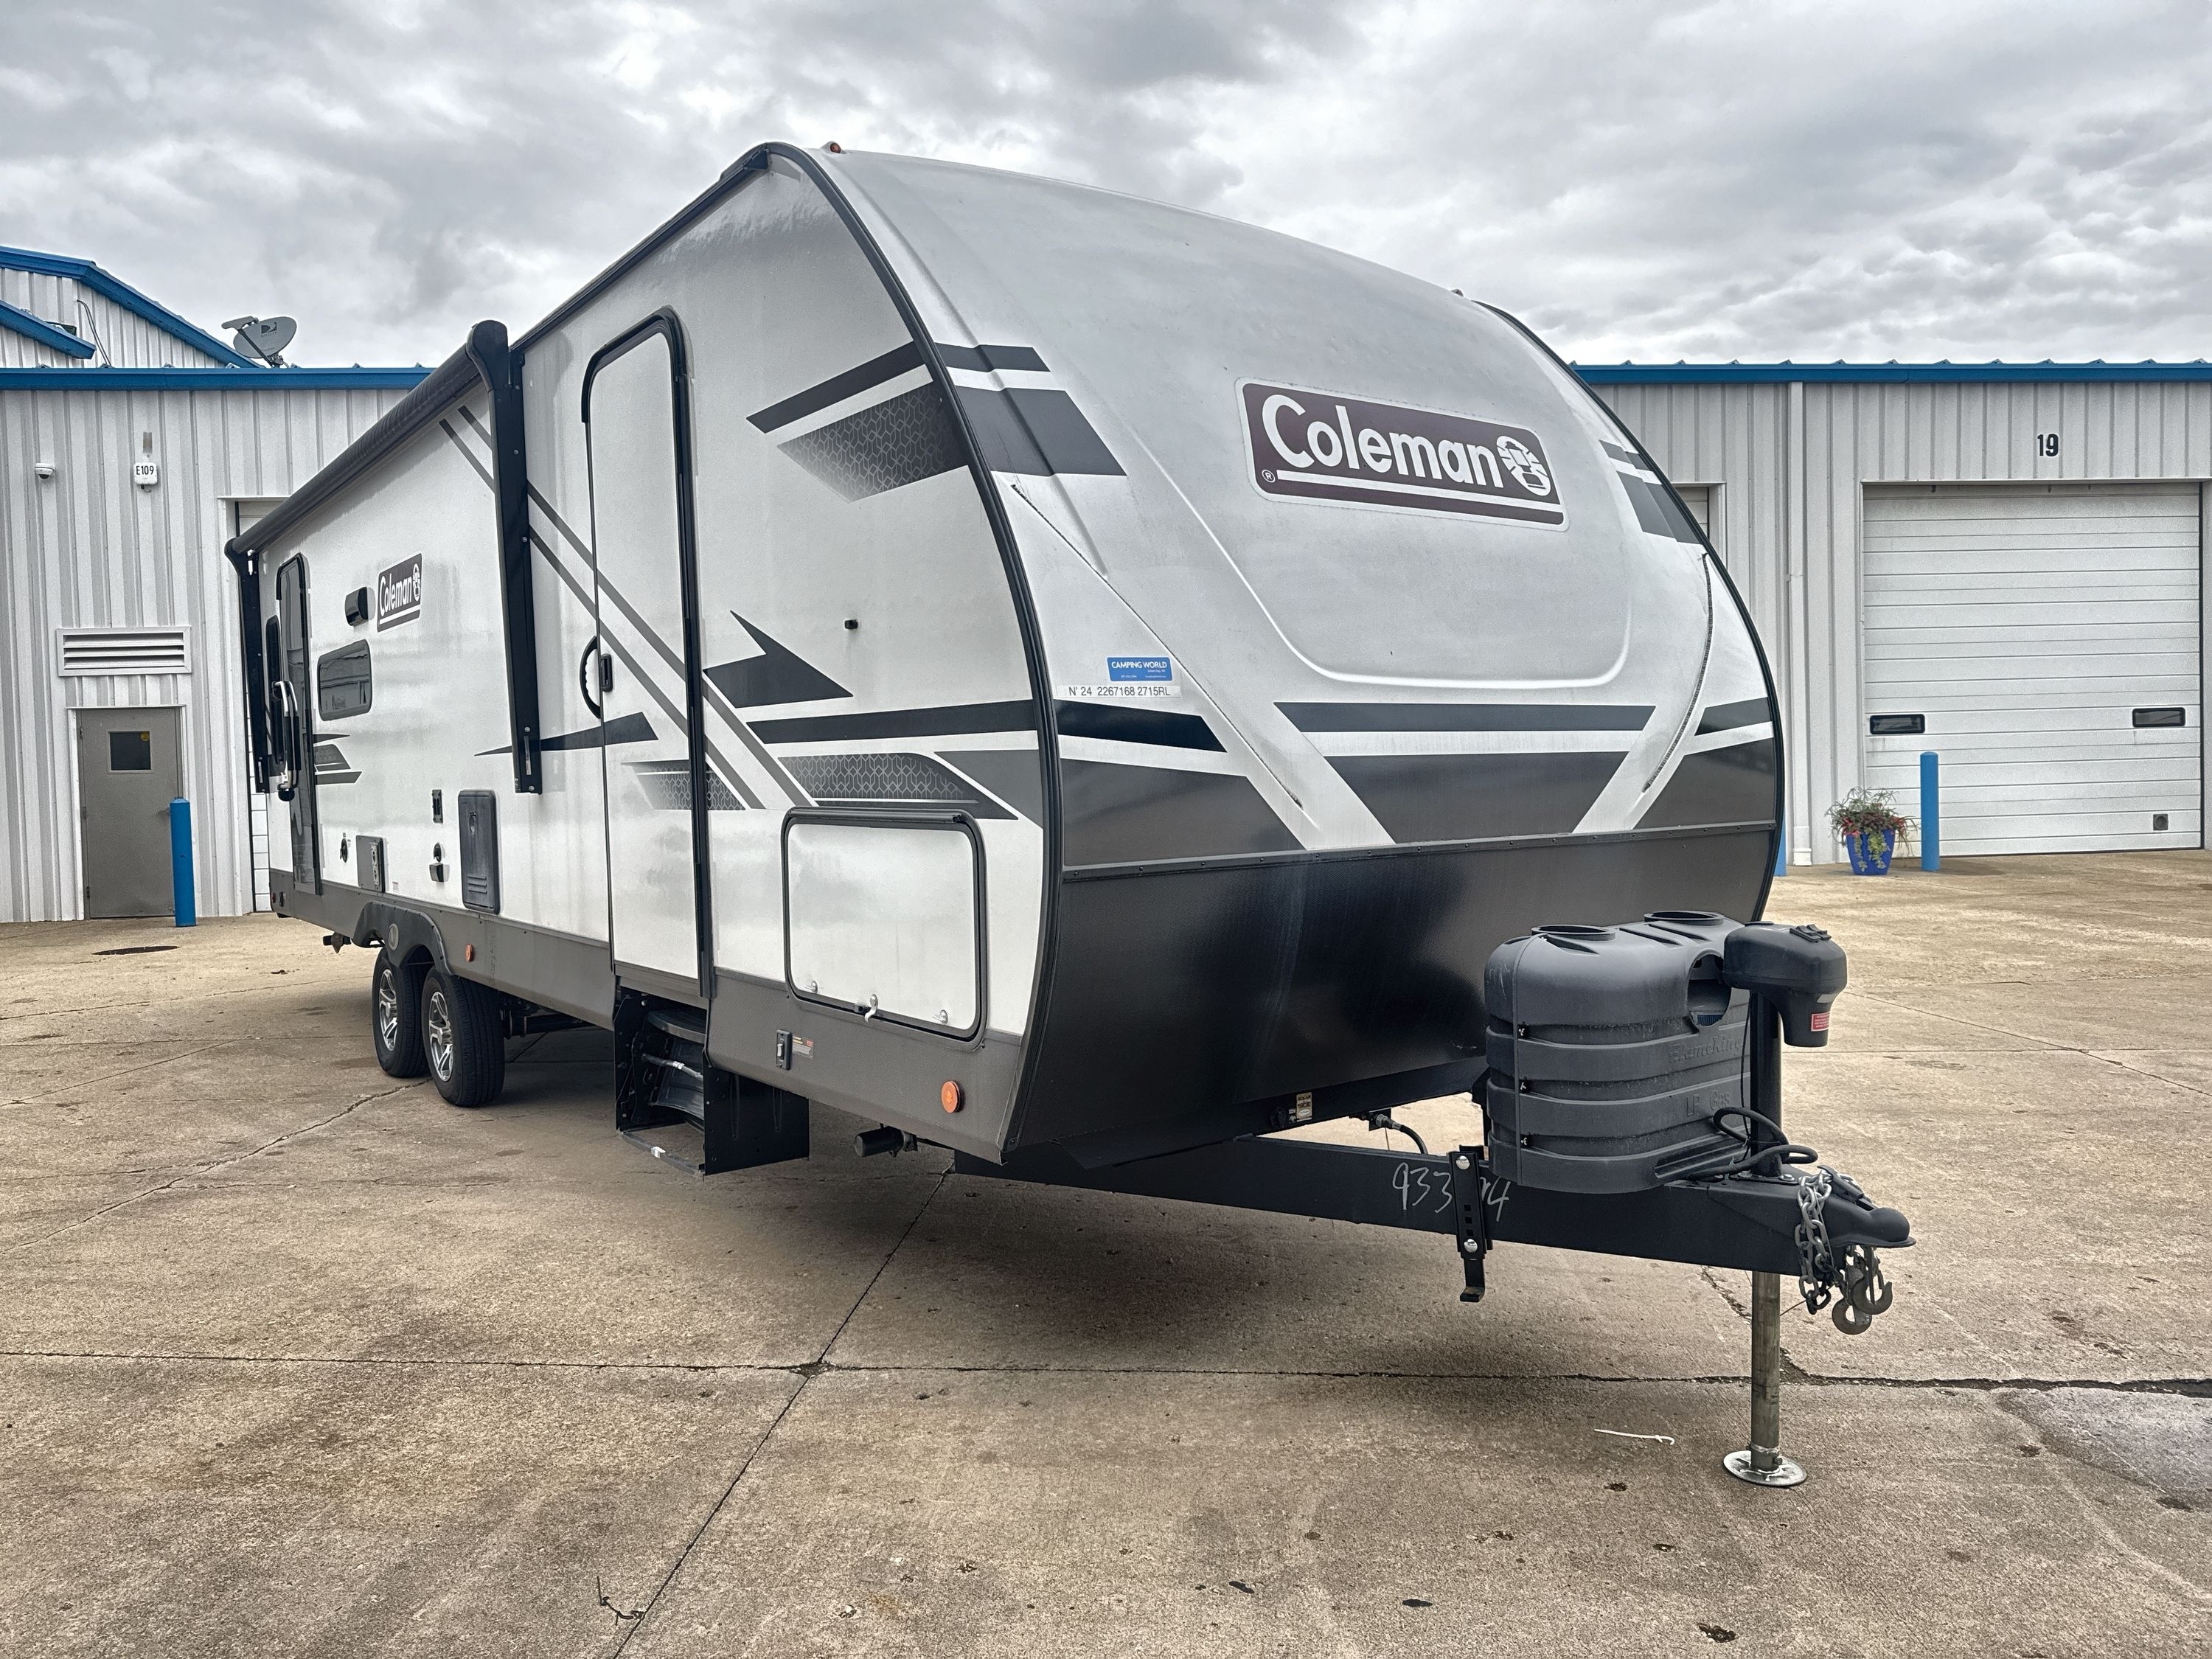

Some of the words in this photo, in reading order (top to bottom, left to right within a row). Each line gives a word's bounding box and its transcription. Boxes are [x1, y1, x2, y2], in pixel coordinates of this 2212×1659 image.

[1262, 394, 1504, 488] Coleman
[2037, 433, 2059, 457] 19
[136, 465, 154, 476] E109
[379, 573, 413, 616] Coleman
[1111, 661, 1142, 669] CAMPING
[1143, 661, 1168, 669] WORLD
[1080, 686, 1092, 696] 24
[1097, 686, 1135, 696] 2267168
[1137, 686, 1171, 696] 2715RL
